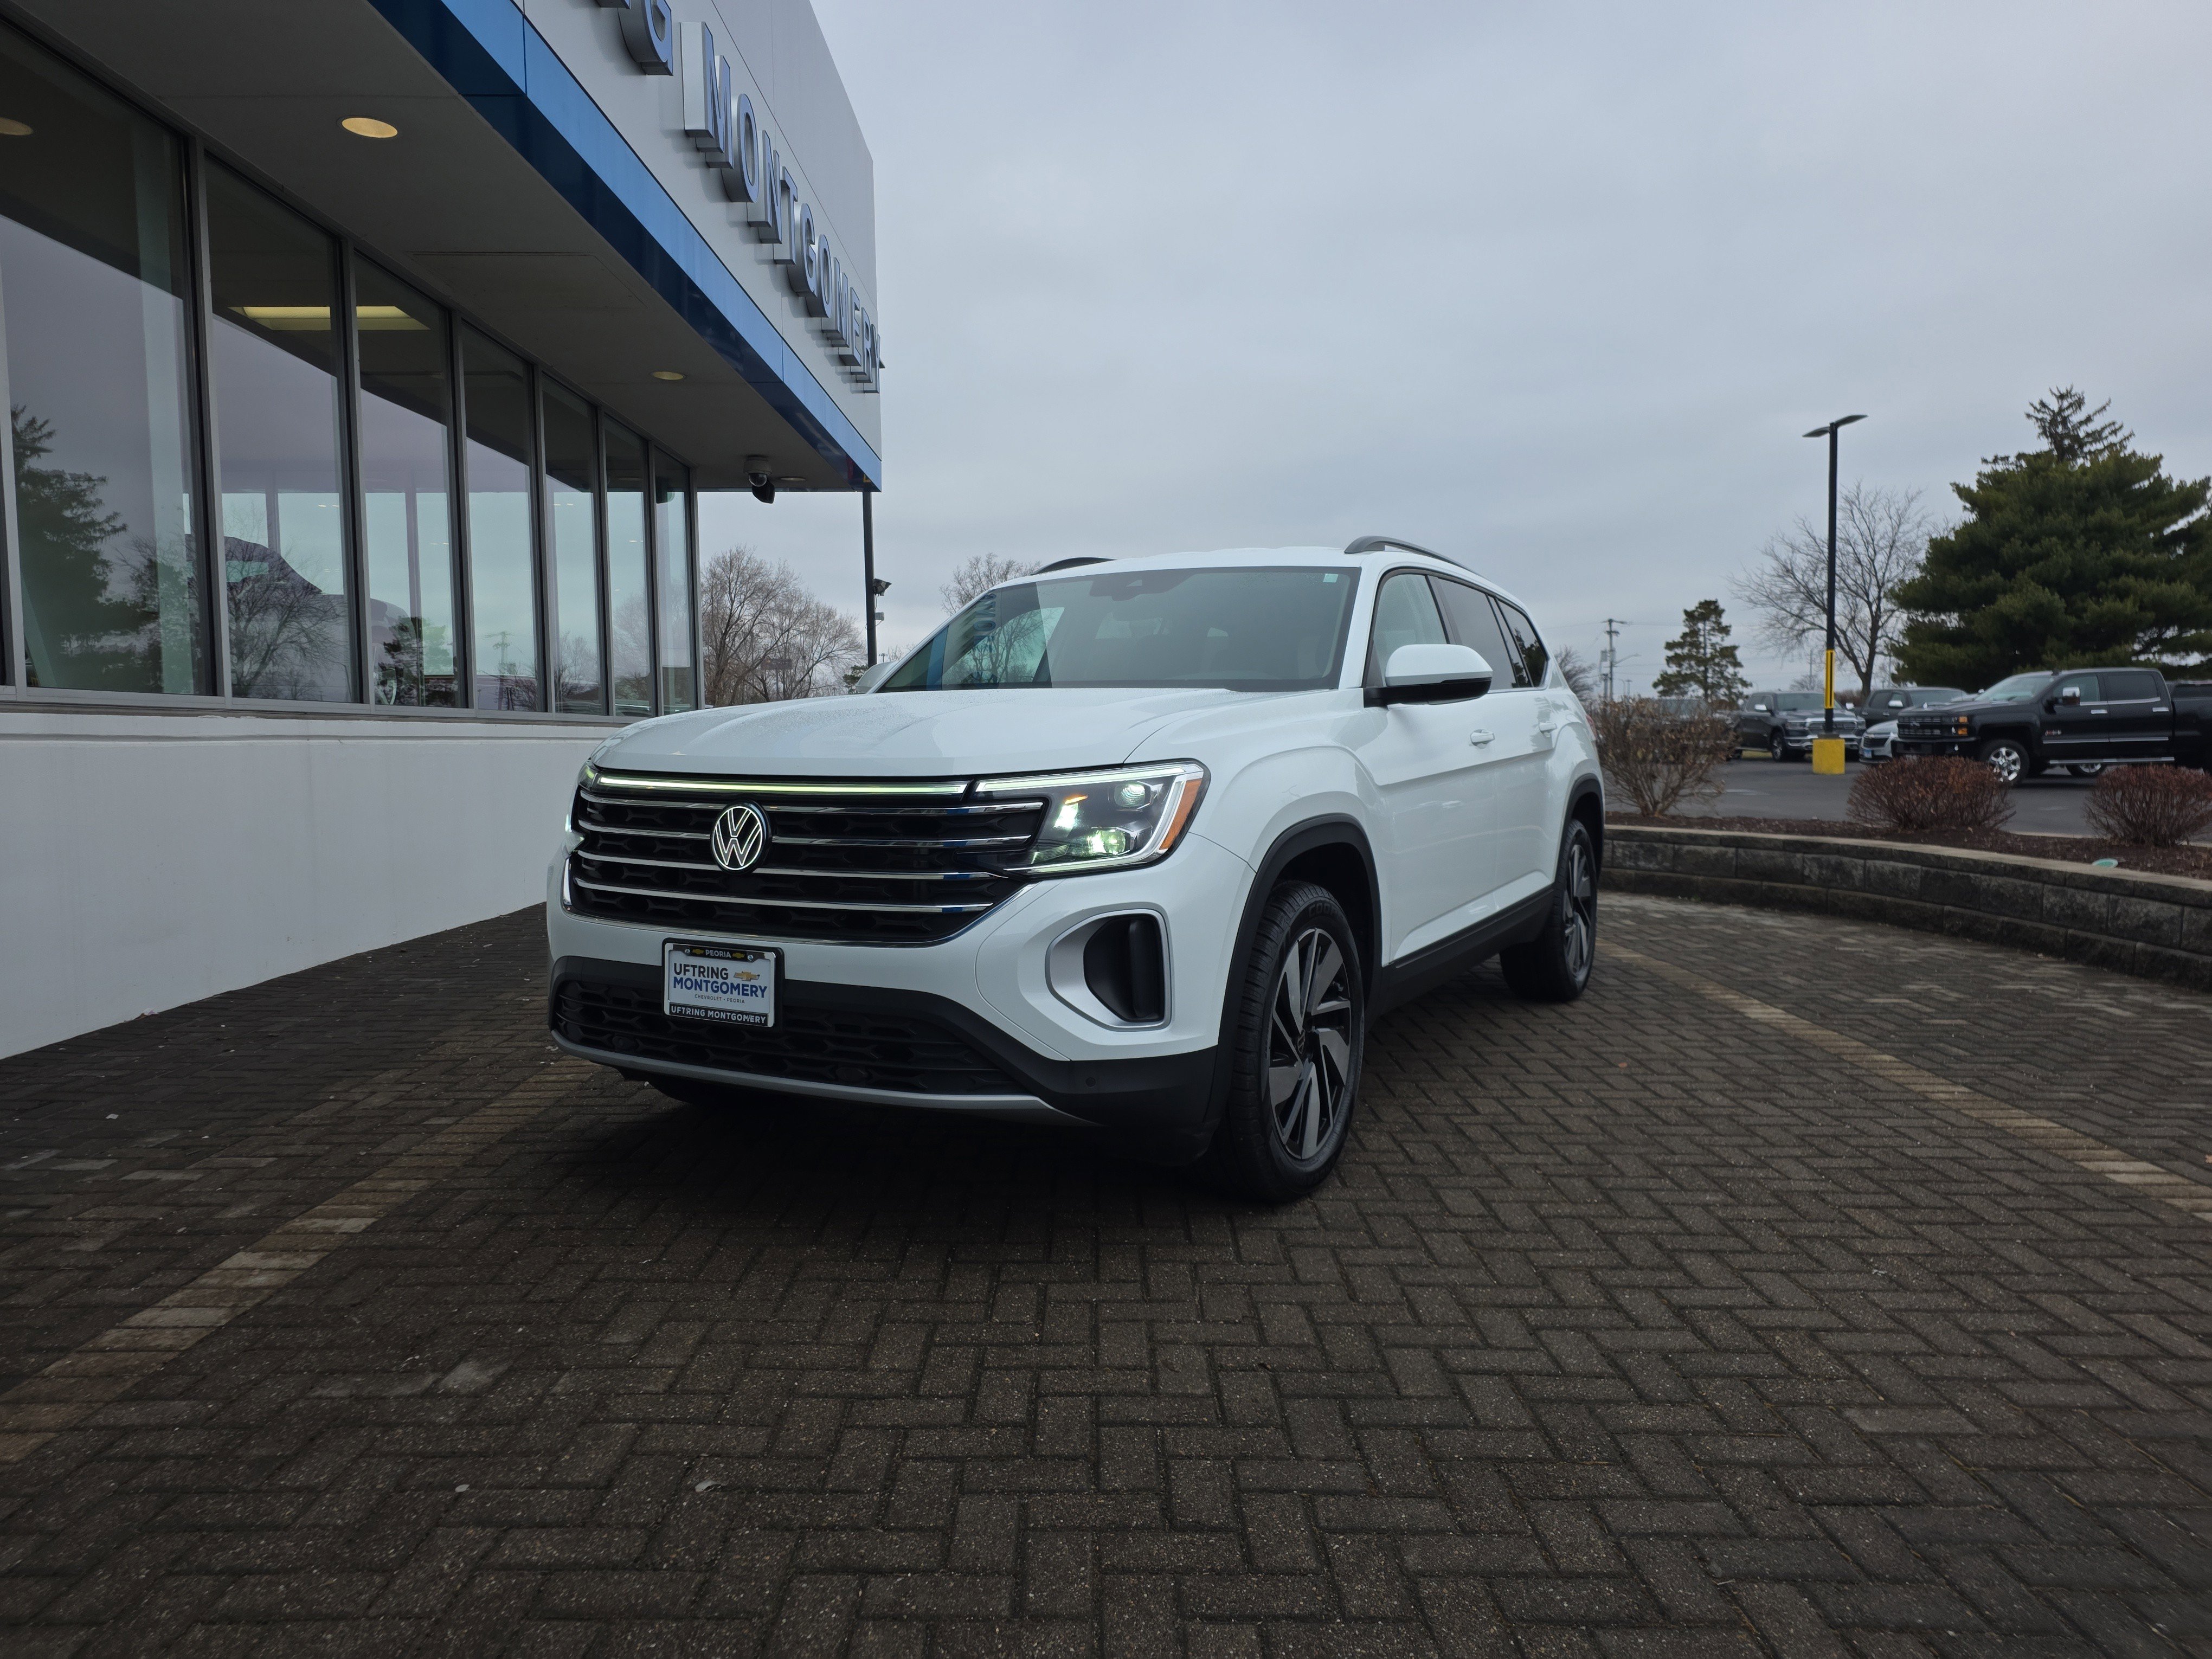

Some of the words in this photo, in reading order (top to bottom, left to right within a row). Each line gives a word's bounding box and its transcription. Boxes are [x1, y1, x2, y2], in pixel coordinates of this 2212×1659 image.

[680, 21, 884, 394] MONTGOMERY
[713, 807, 762, 867] VW
[705, 949, 731, 959] PEORIA
[673, 963, 729, 980] UFTRING
[673, 976, 768, 998] MONTGOMERY
[671, 1005, 705, 1017] UFTRING
[708, 1010, 766, 1024] MONTGOMERY
